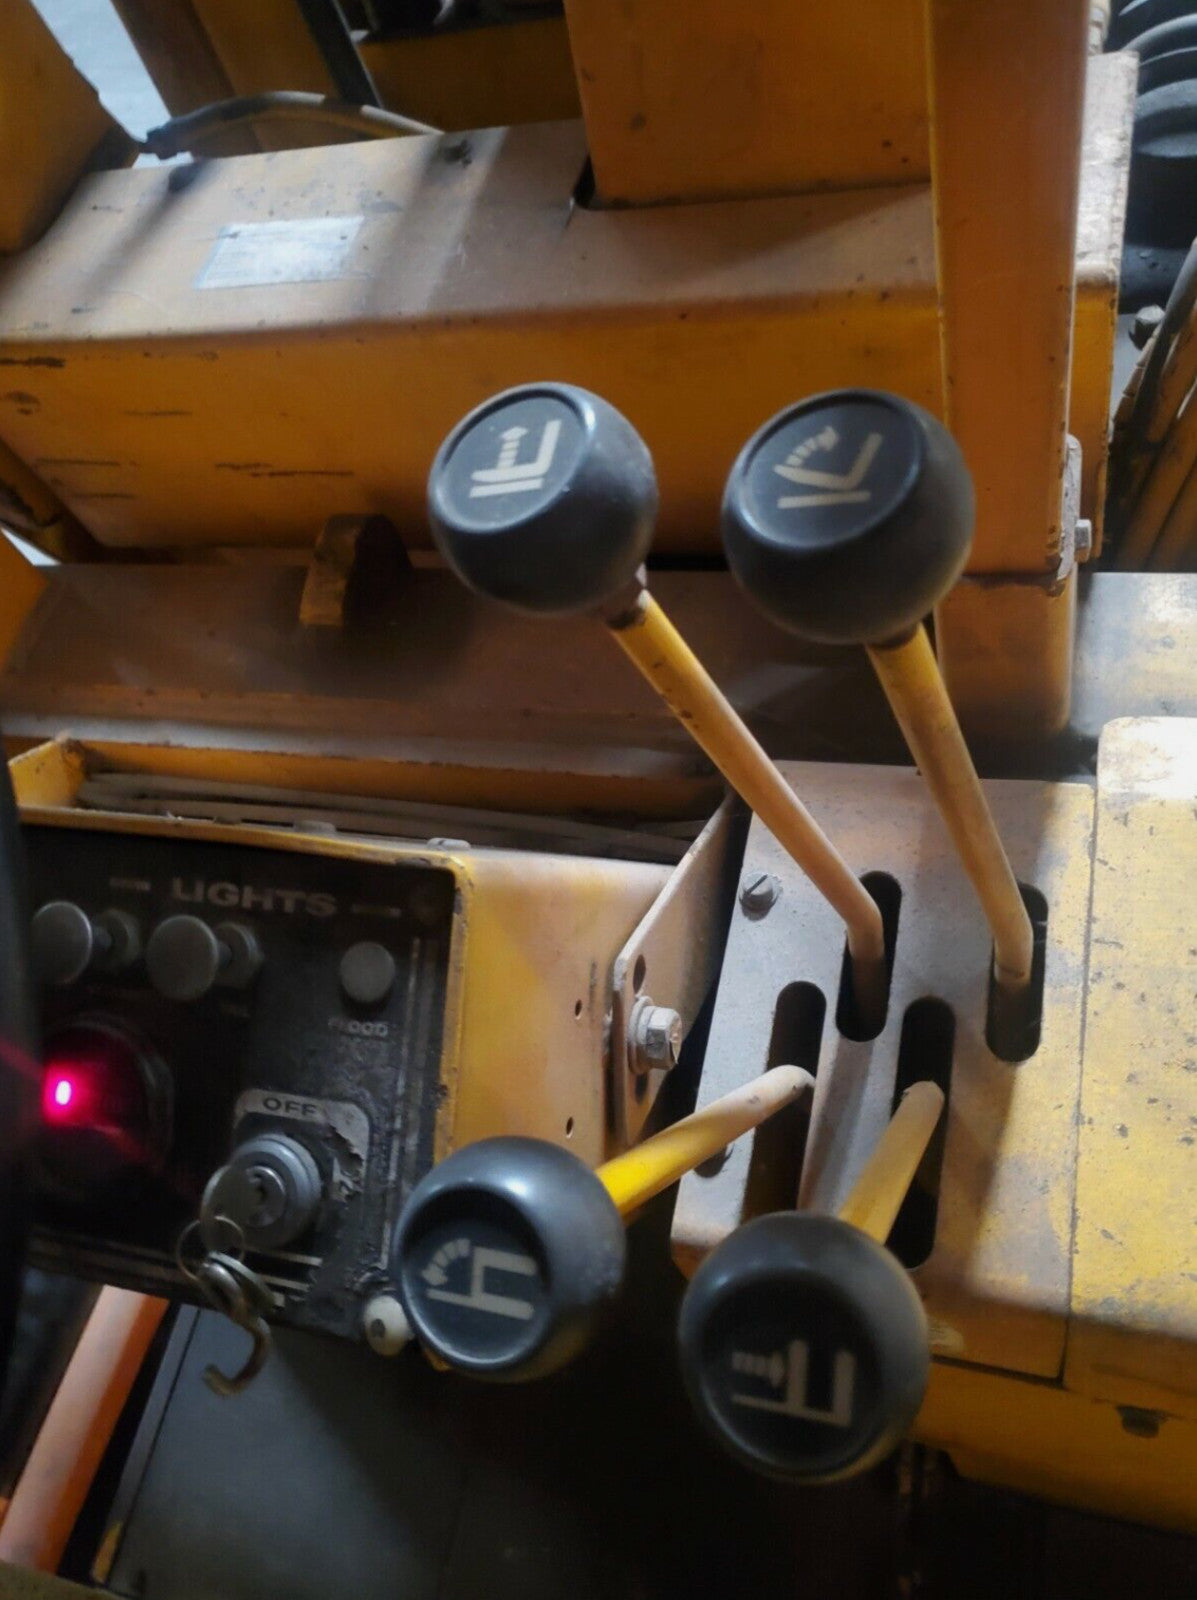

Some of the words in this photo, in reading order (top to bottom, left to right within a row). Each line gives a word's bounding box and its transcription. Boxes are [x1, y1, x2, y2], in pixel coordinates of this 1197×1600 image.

[172, 877, 337, 917] LIGHTS
[328, 1017, 388, 1036] OOD
[263, 1097, 316, 1116] OFF
